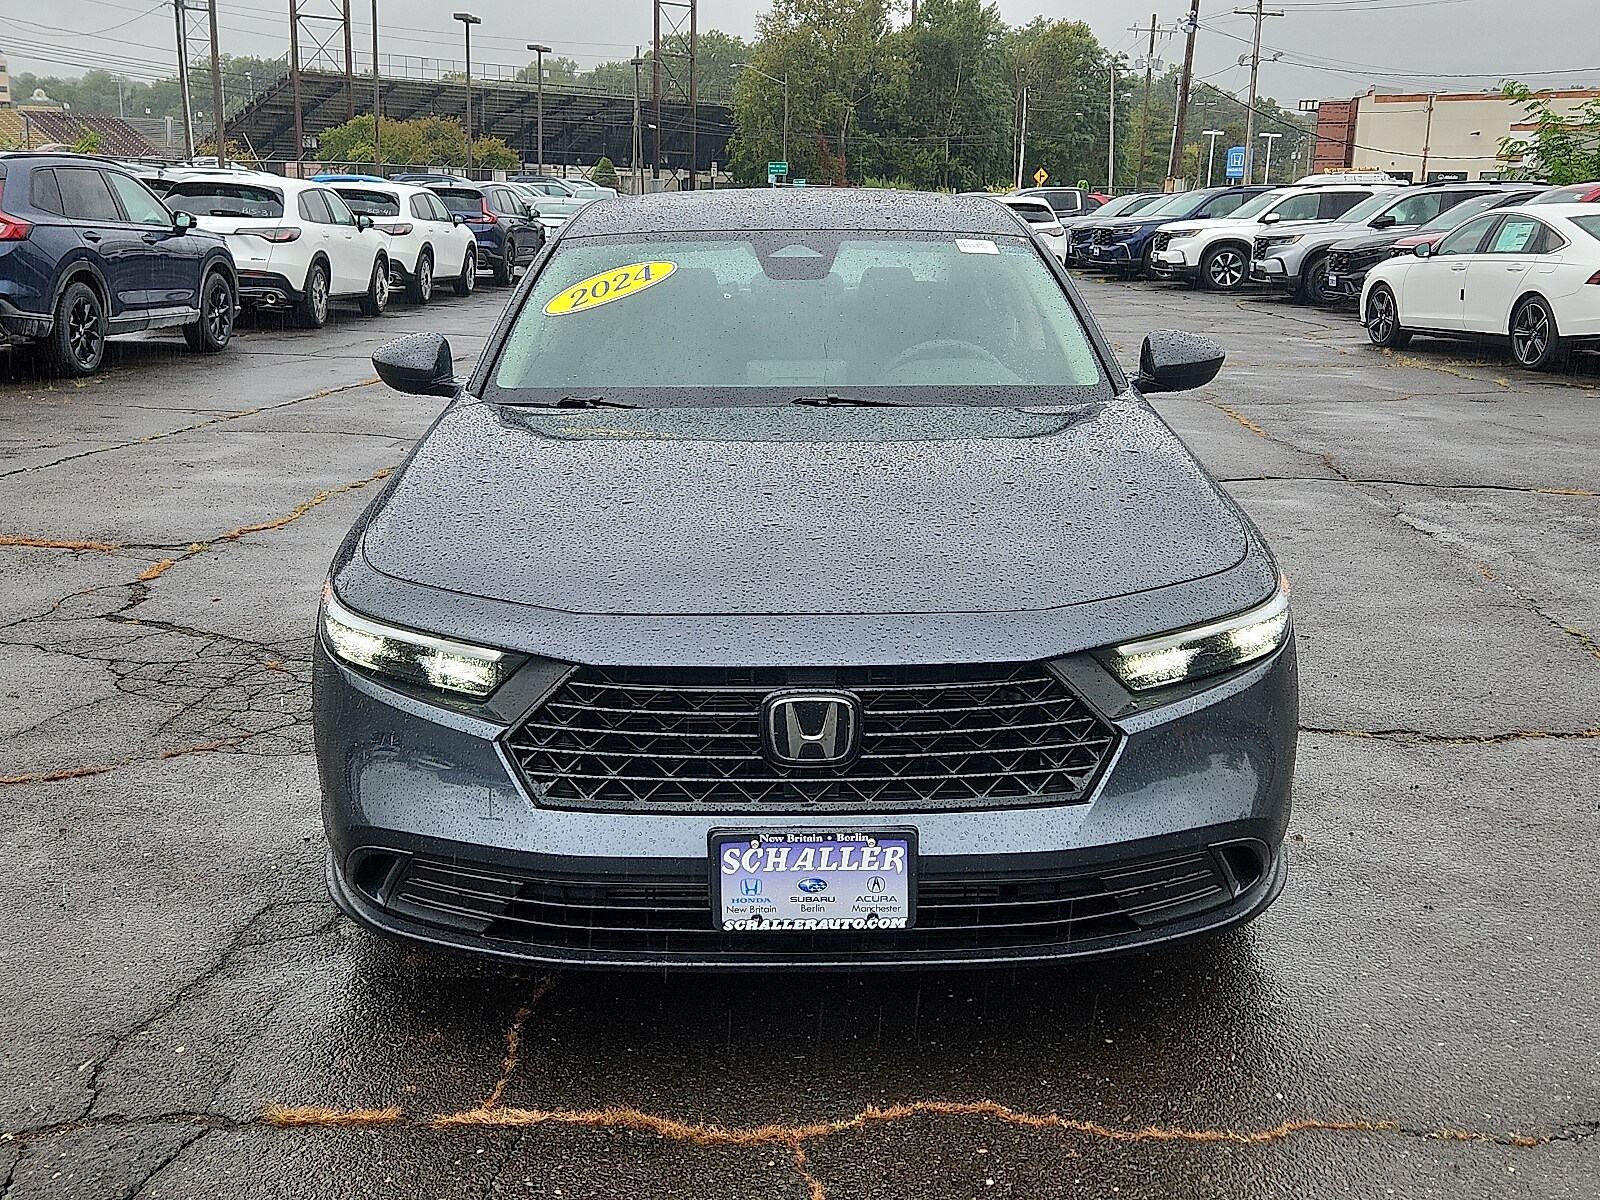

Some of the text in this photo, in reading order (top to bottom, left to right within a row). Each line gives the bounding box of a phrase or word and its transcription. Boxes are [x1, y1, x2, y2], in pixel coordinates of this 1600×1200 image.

[570, 264, 656, 309] 2024
[759, 833, 869, 843] New Britain Berlin
[721, 846, 906, 875] SCHALLER
[855, 895, 898, 903] ACURA
[726, 905, 777, 914] New Britain
[800, 904, 826, 913] Berlin
[851, 904, 902, 913] Manchester
[722, 917, 908, 931] SCHALLERAUTO.COM
